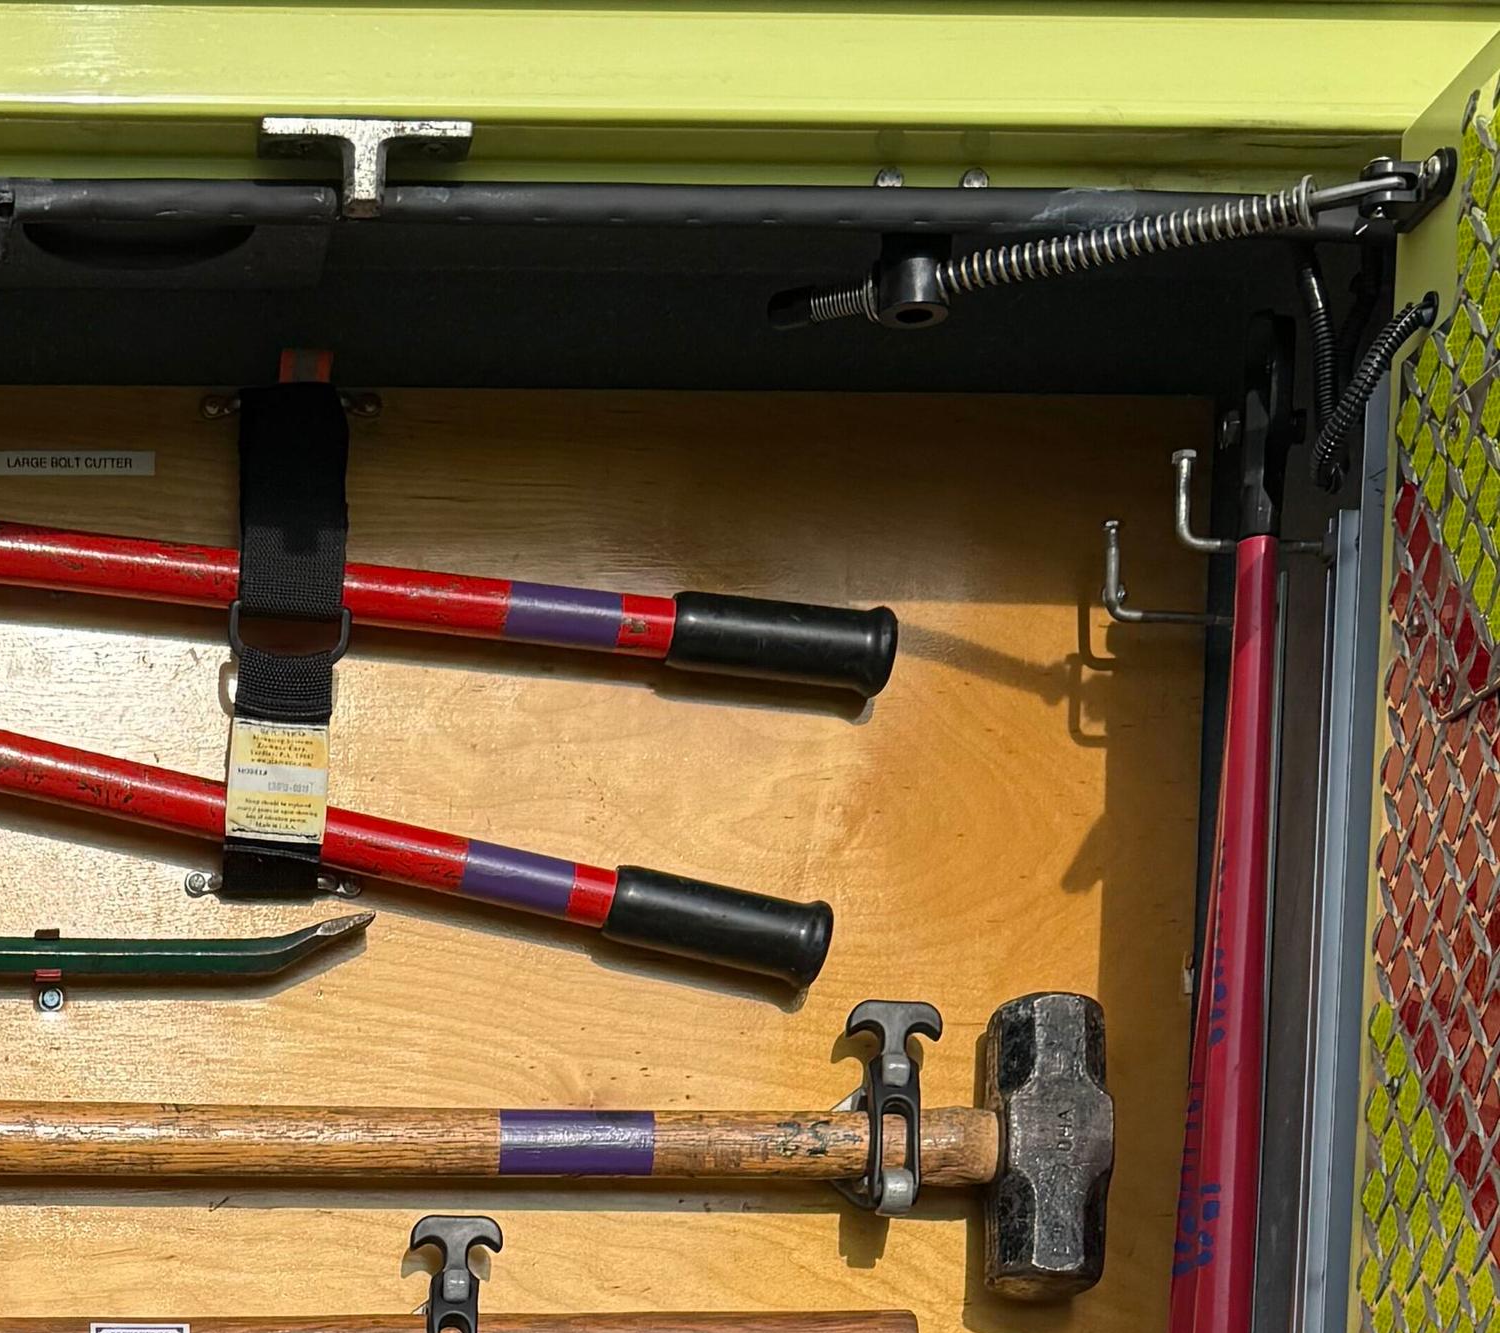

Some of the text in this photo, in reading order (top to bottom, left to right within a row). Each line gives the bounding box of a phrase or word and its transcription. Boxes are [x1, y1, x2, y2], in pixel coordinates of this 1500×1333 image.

[6, 456, 133, 469] LARGE BOLT CUTTER
